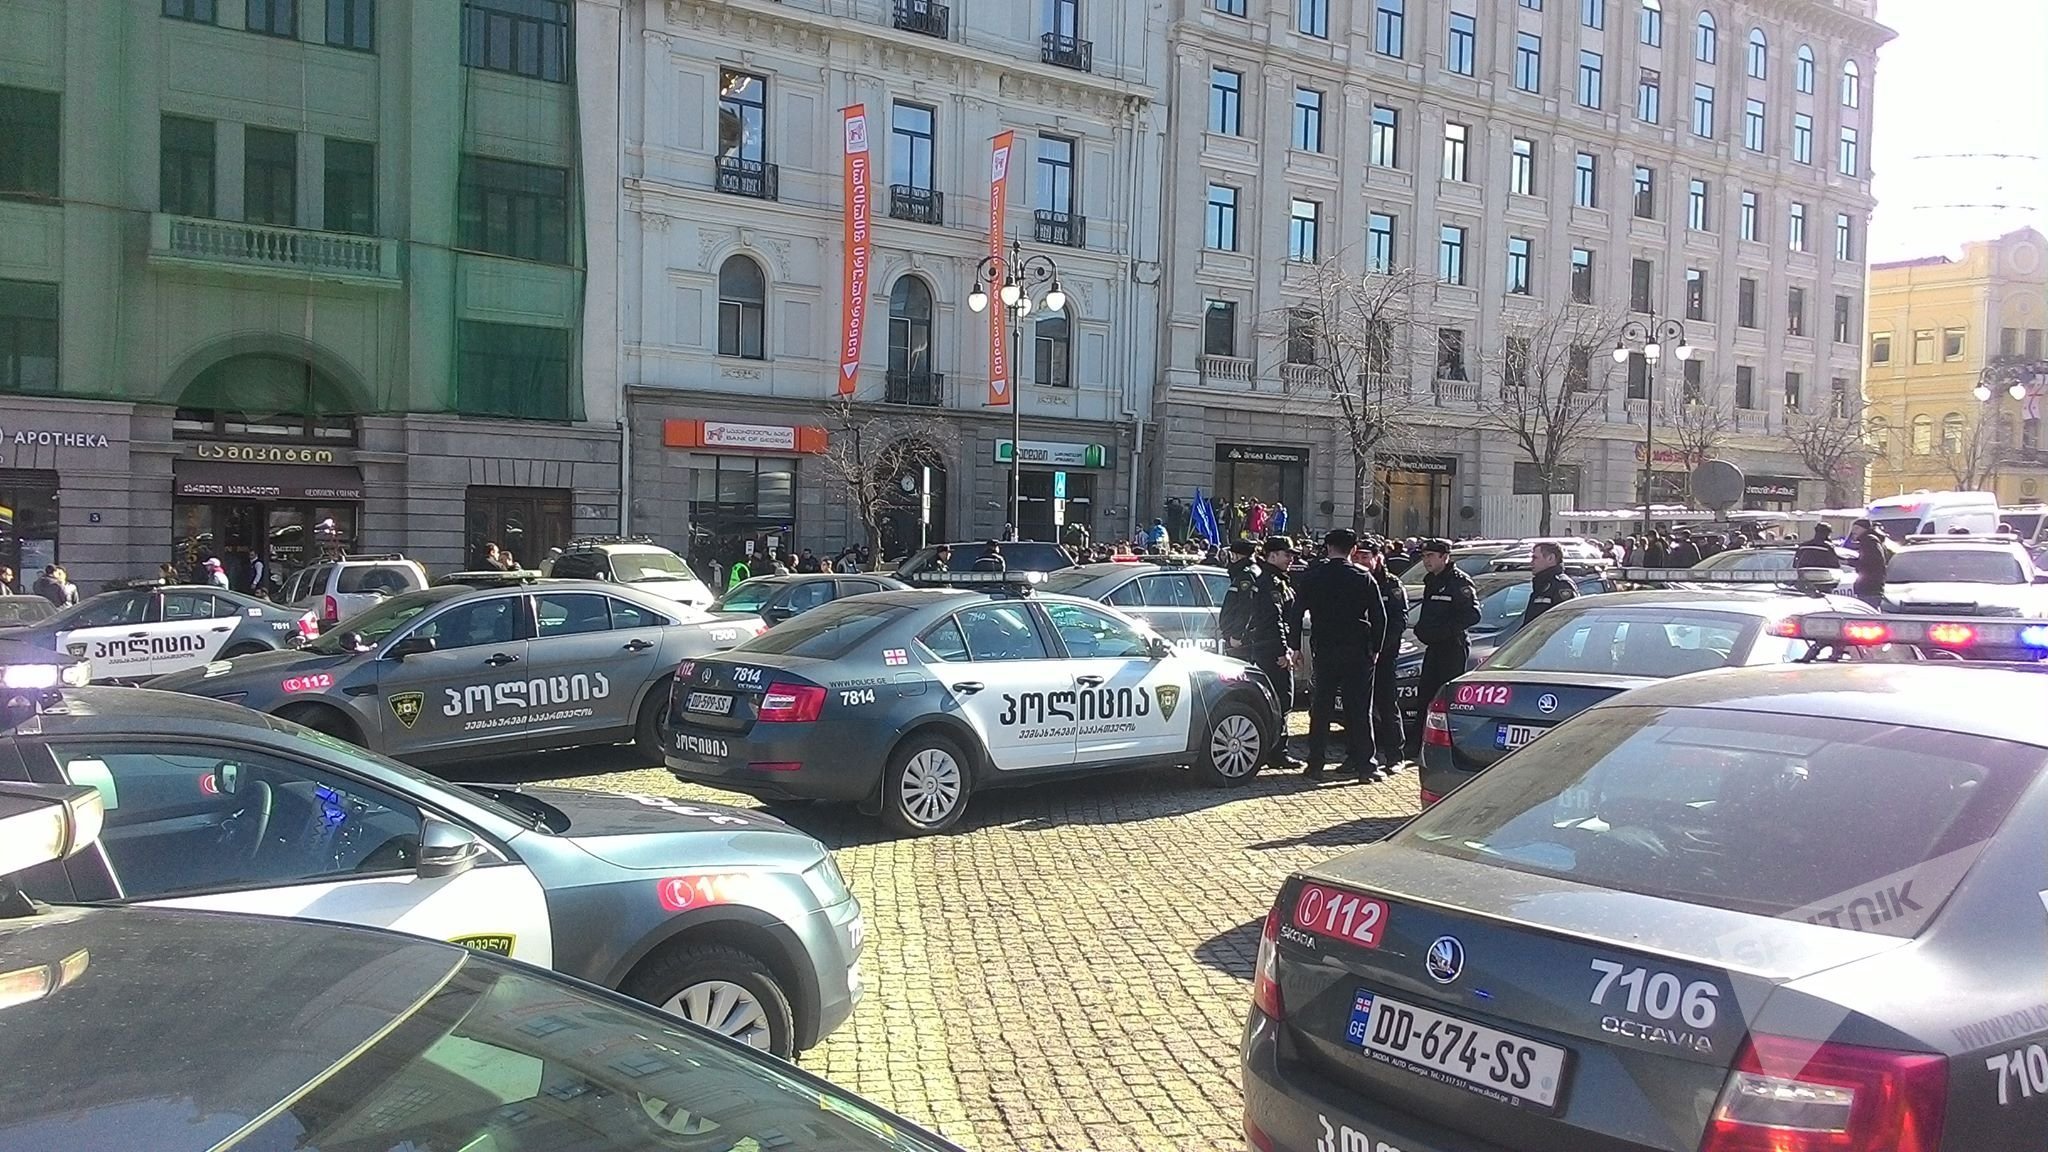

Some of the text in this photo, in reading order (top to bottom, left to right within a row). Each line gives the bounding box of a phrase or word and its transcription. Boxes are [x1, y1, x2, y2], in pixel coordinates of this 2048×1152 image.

[852, 158, 866, 243] ფილიალი
[847, 247, 866, 357] ცენტრალური
[14, 431, 108, 448] APOTHEKA
[198, 445, 333, 463] სამიკიტნო
[709, 629, 737, 642] 7500
[95, 634, 206, 659] პოლიცია
[302, 674, 331, 688] 112
[733, 667, 762, 683] 7814
[442, 671, 611, 717] პოლიცია
[839, 689, 876, 706] 7814
[1475, 686, 1508, 704] 112
[1000, 687, 1150, 725] პოლიცია
[528, 708, 594, 724] საქართველოს
[1078, 722, 1137, 736] საქართველოს
[1509, 728, 1545, 745] DD-
[675, 733, 728, 757] პოლიცია
[1325, 893, 1381, 943] 112
[460, 938, 509, 950] თველო
[1590, 958, 1720, 1029] 7106
[1349, 1020, 1366, 1039] GE
[1601, 1016, 1714, 1053] OCTAVIA
[1371, 1004, 1537, 1089] DD-674-SS
[1391, 1057, 1407, 1069] AUTO
[1408, 1063, 1428, 1077] Georgia
